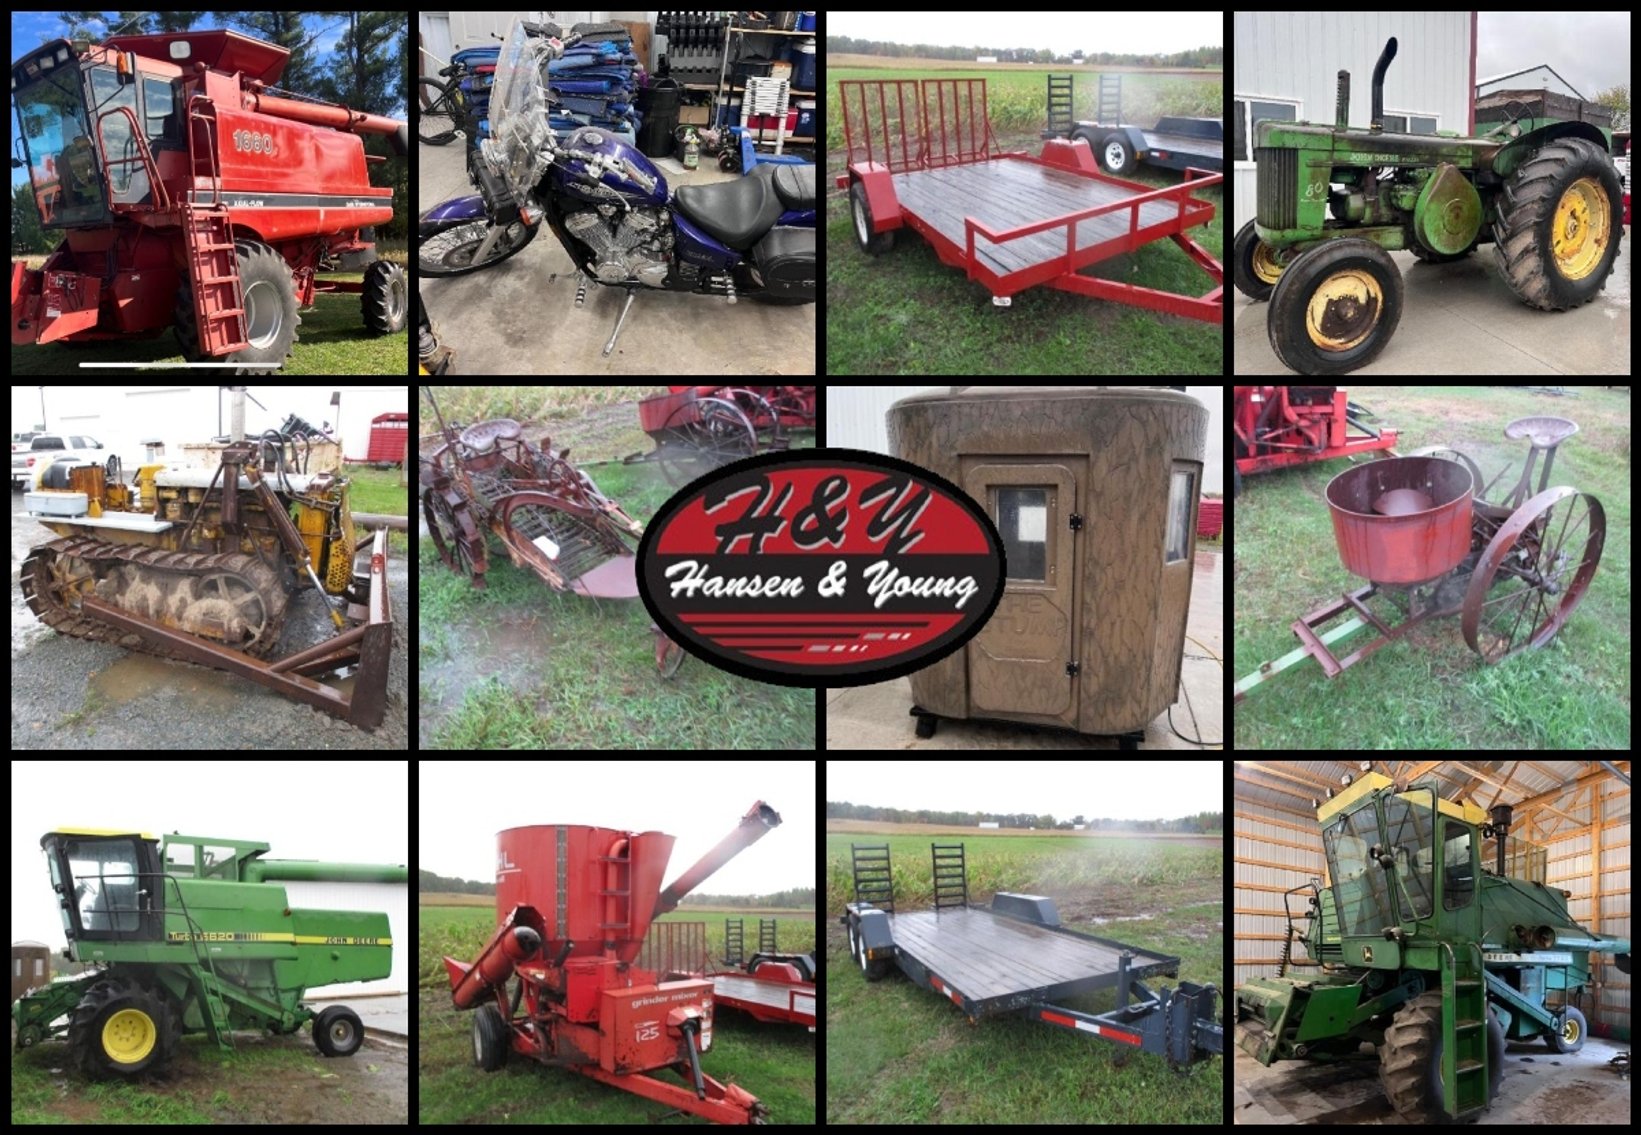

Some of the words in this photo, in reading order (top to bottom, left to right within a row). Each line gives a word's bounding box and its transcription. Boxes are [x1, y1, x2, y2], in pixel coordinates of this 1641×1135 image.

[232, 129, 273, 155] 1660
[631, 996, 669, 1009] grinder
[635, 1026, 660, 1043] 125
